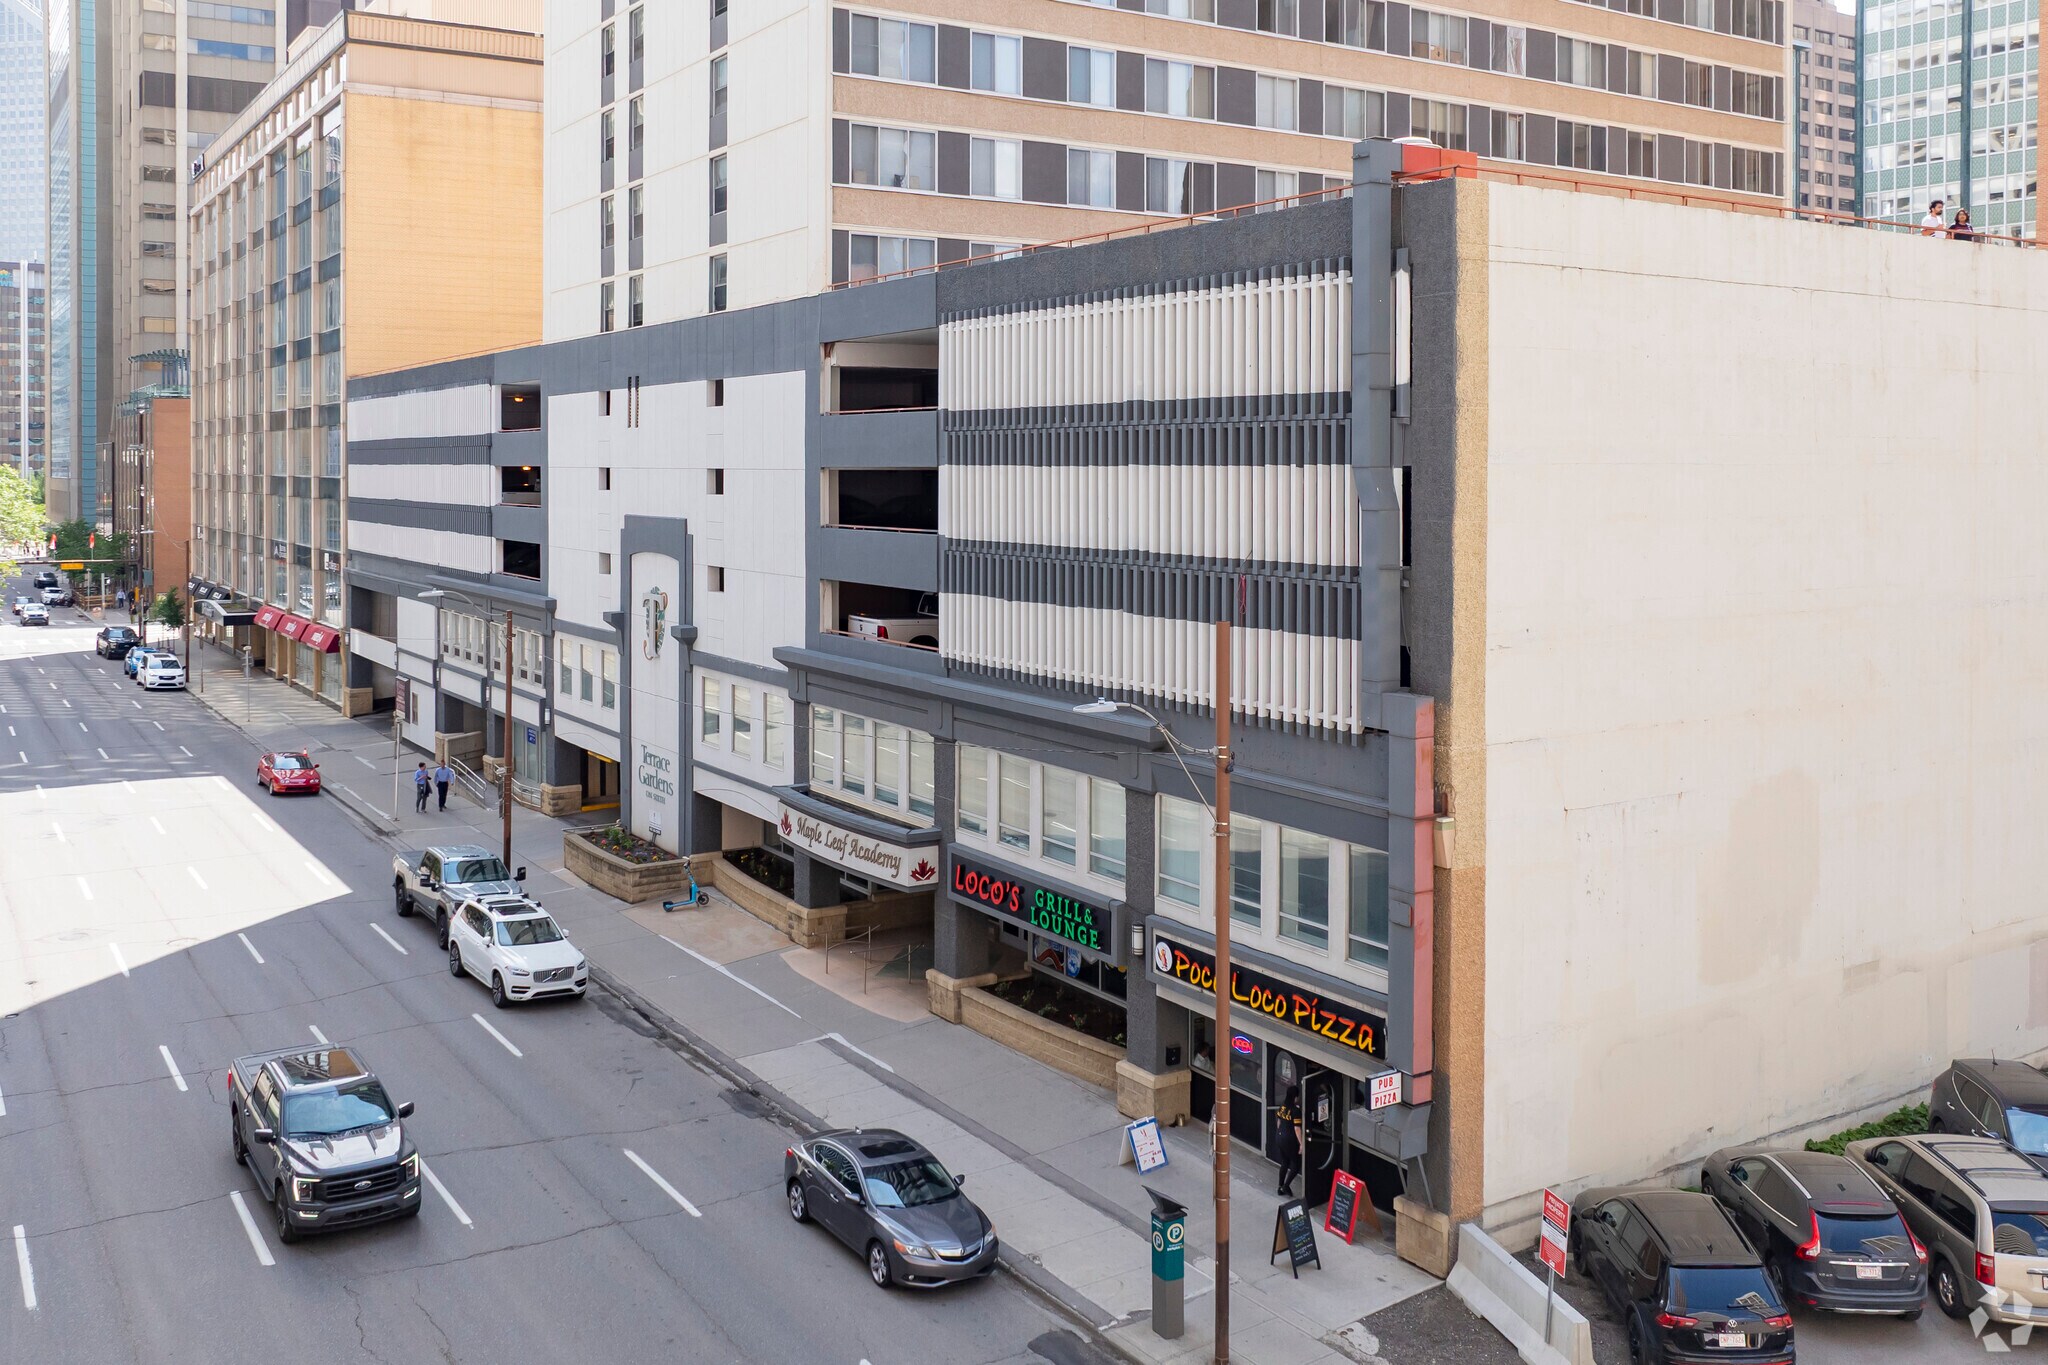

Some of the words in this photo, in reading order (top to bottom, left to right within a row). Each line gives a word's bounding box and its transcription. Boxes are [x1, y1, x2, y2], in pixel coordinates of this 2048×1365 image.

[640, 744, 671, 773] Terrace
[638, 764, 674, 797] Gardens
[796, 817, 822, 848] Maple
[824, 830, 849, 861] Leaf
[849, 837, 902, 879] Academy
[955, 864, 1020, 912] LOCO'S
[1030, 906, 1099, 950] LOUNGE
[1231, 1037, 1253, 1054] OPEN
[1378, 1077, 1393, 1089] PUB
[1374, 1092, 1397, 1107] PIZZA
[1172, 1227, 1180, 1239] P
